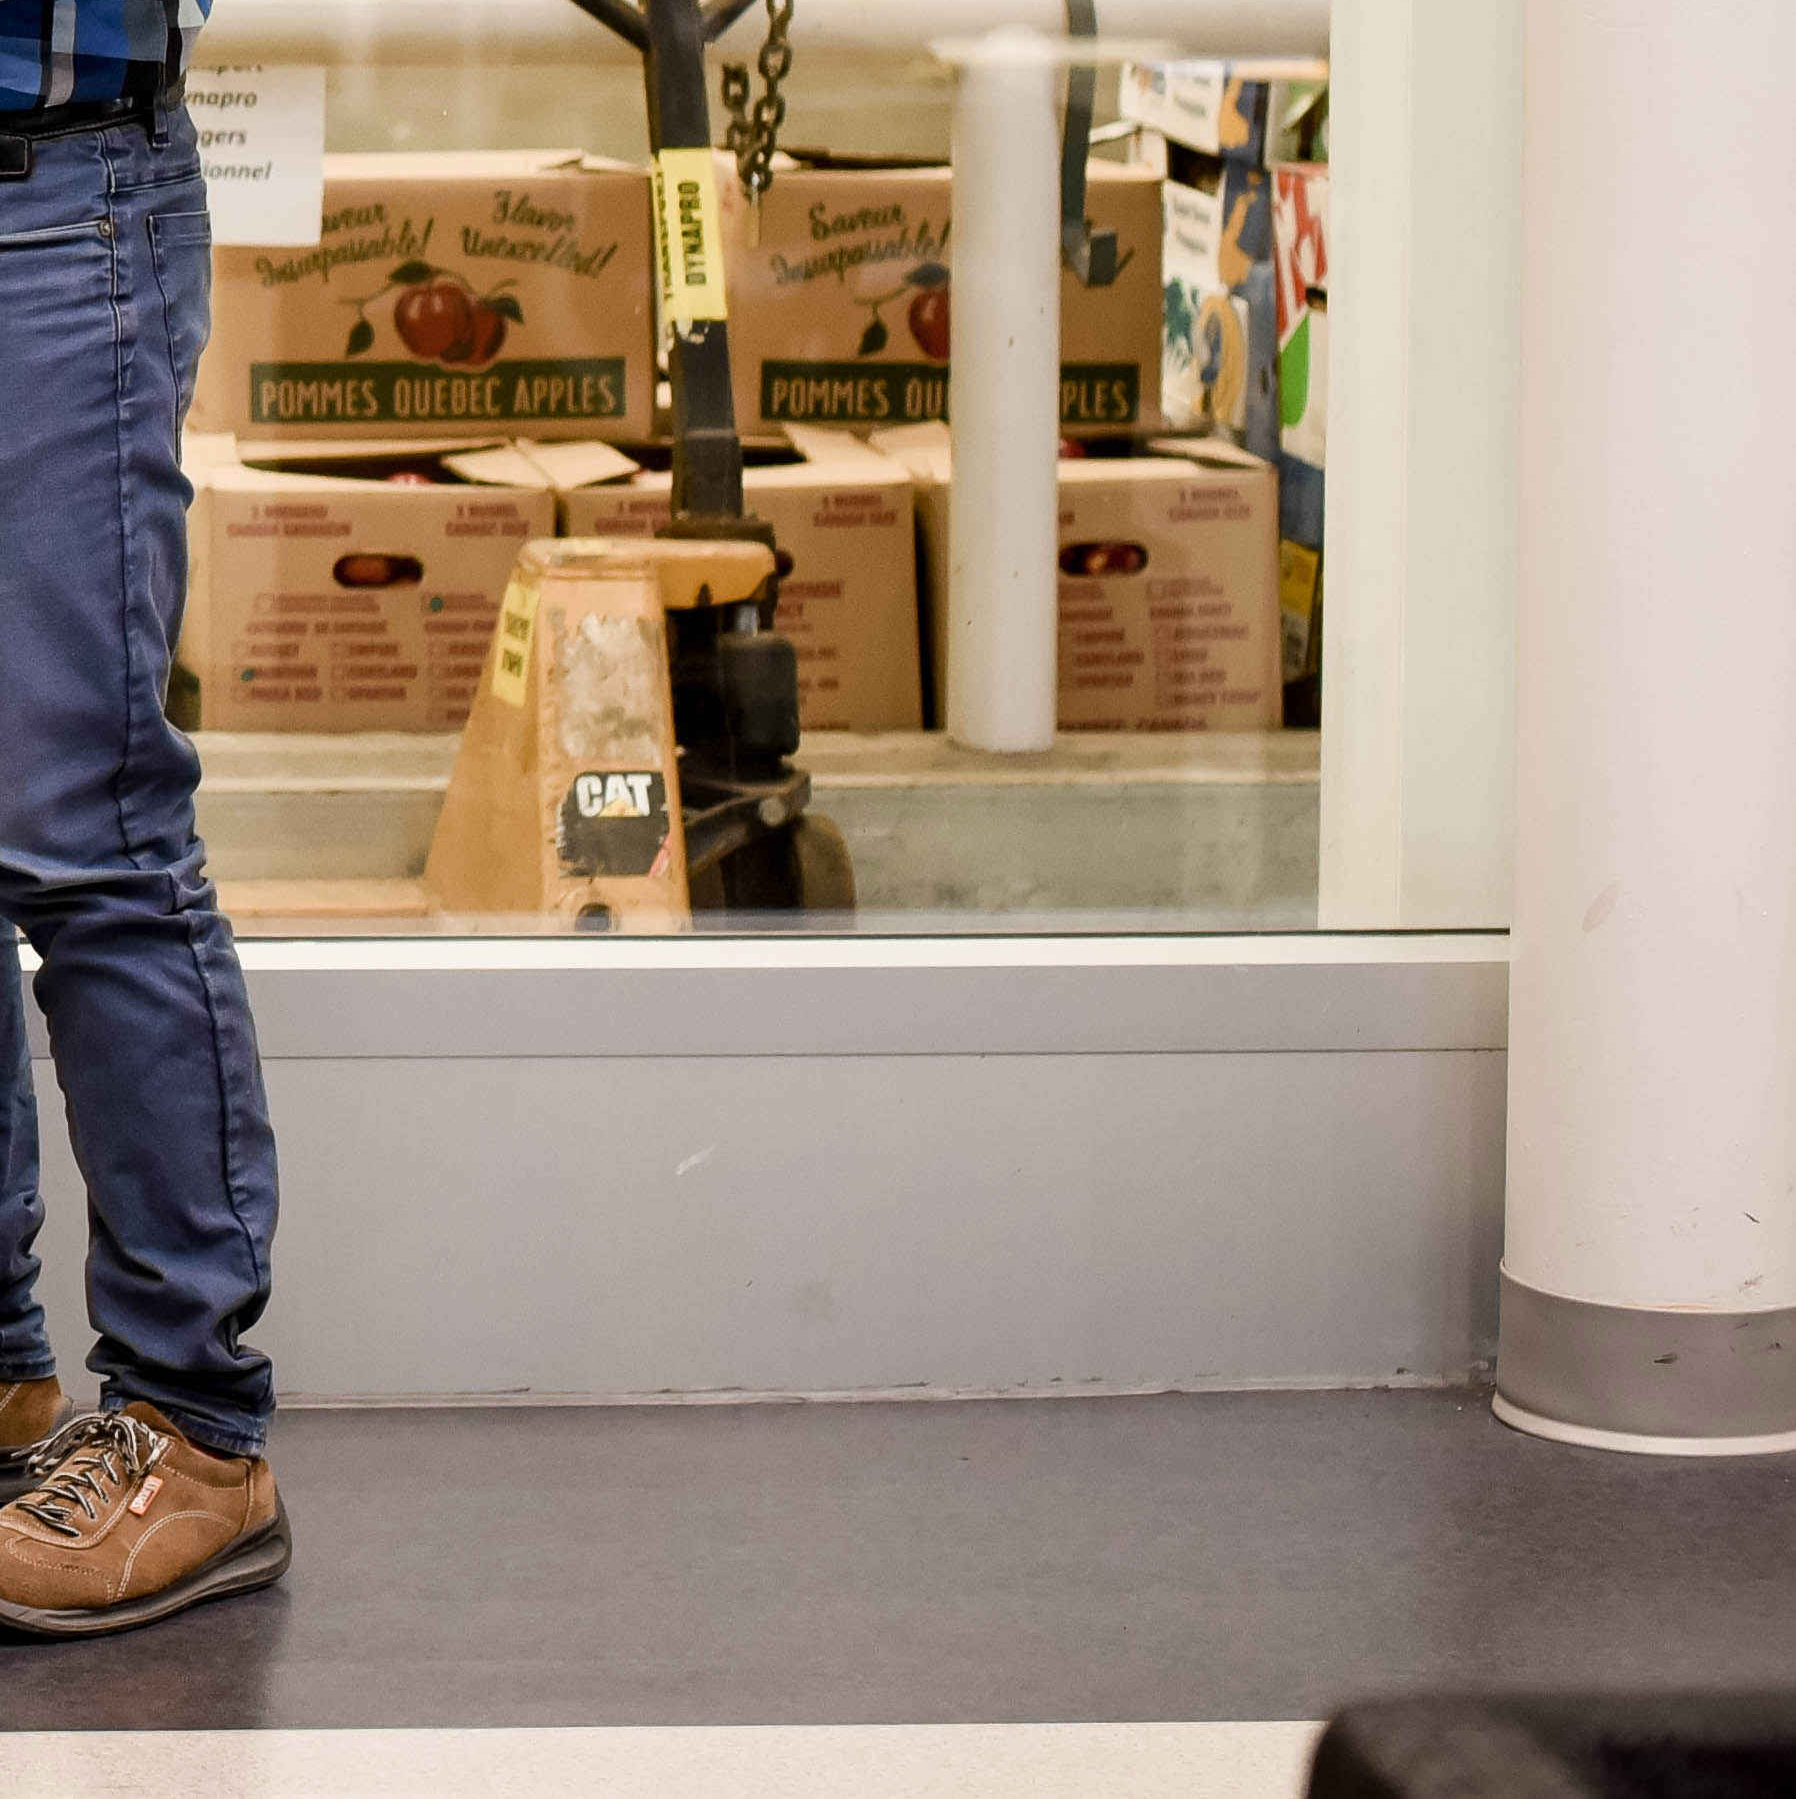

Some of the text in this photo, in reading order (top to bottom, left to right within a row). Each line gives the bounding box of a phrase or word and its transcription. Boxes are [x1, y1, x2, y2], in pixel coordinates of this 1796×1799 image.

[200, 129, 247, 147] gers
[202, 161, 272, 180] ionnel
[261, 376, 617, 420] POMMES QUEBEC APPLES
[771, 379, 892, 418] POMMES
[1062, 380, 1130, 421] PLES
[575, 773, 652, 818] CAT
